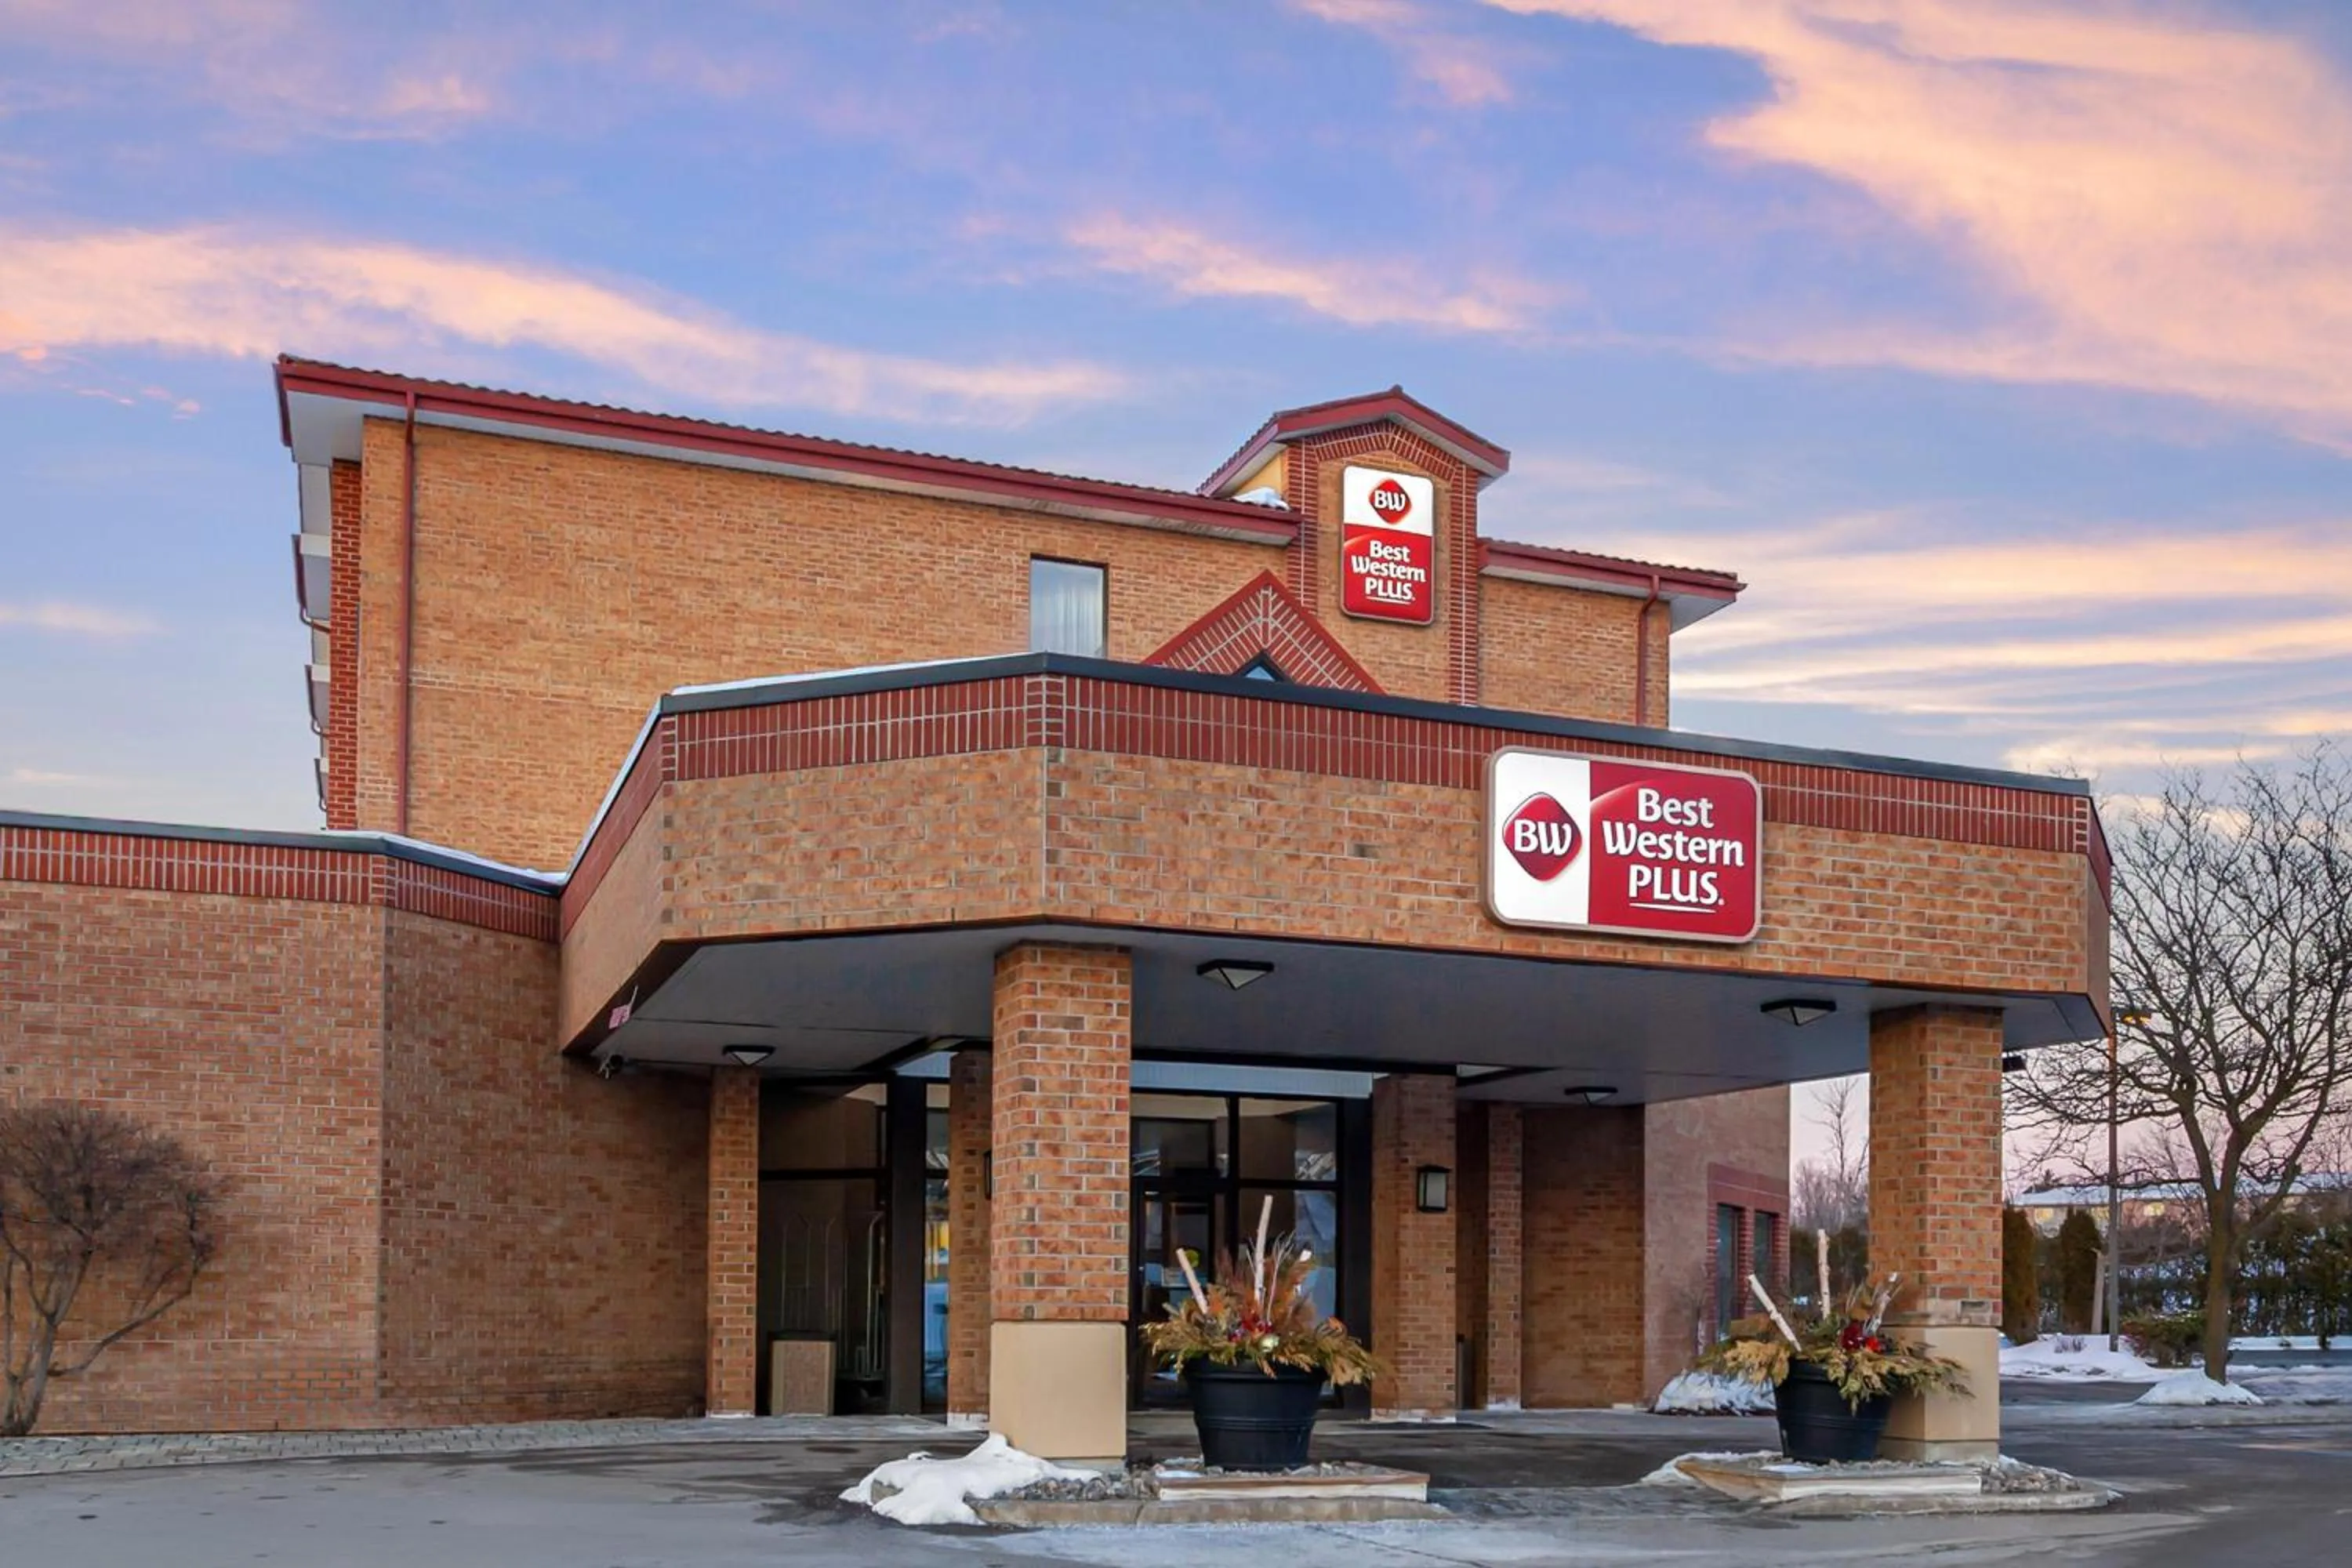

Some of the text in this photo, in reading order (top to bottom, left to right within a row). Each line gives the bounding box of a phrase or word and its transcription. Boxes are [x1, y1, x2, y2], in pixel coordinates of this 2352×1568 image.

[1374, 489, 1406, 512] BW
[1370, 540, 1410, 562] Best
[1351, 555, 1427, 583] Western
[1637, 788, 1714, 829] Best
[1514, 818, 1573, 856] BW
[1602, 820, 1744, 867] Western
